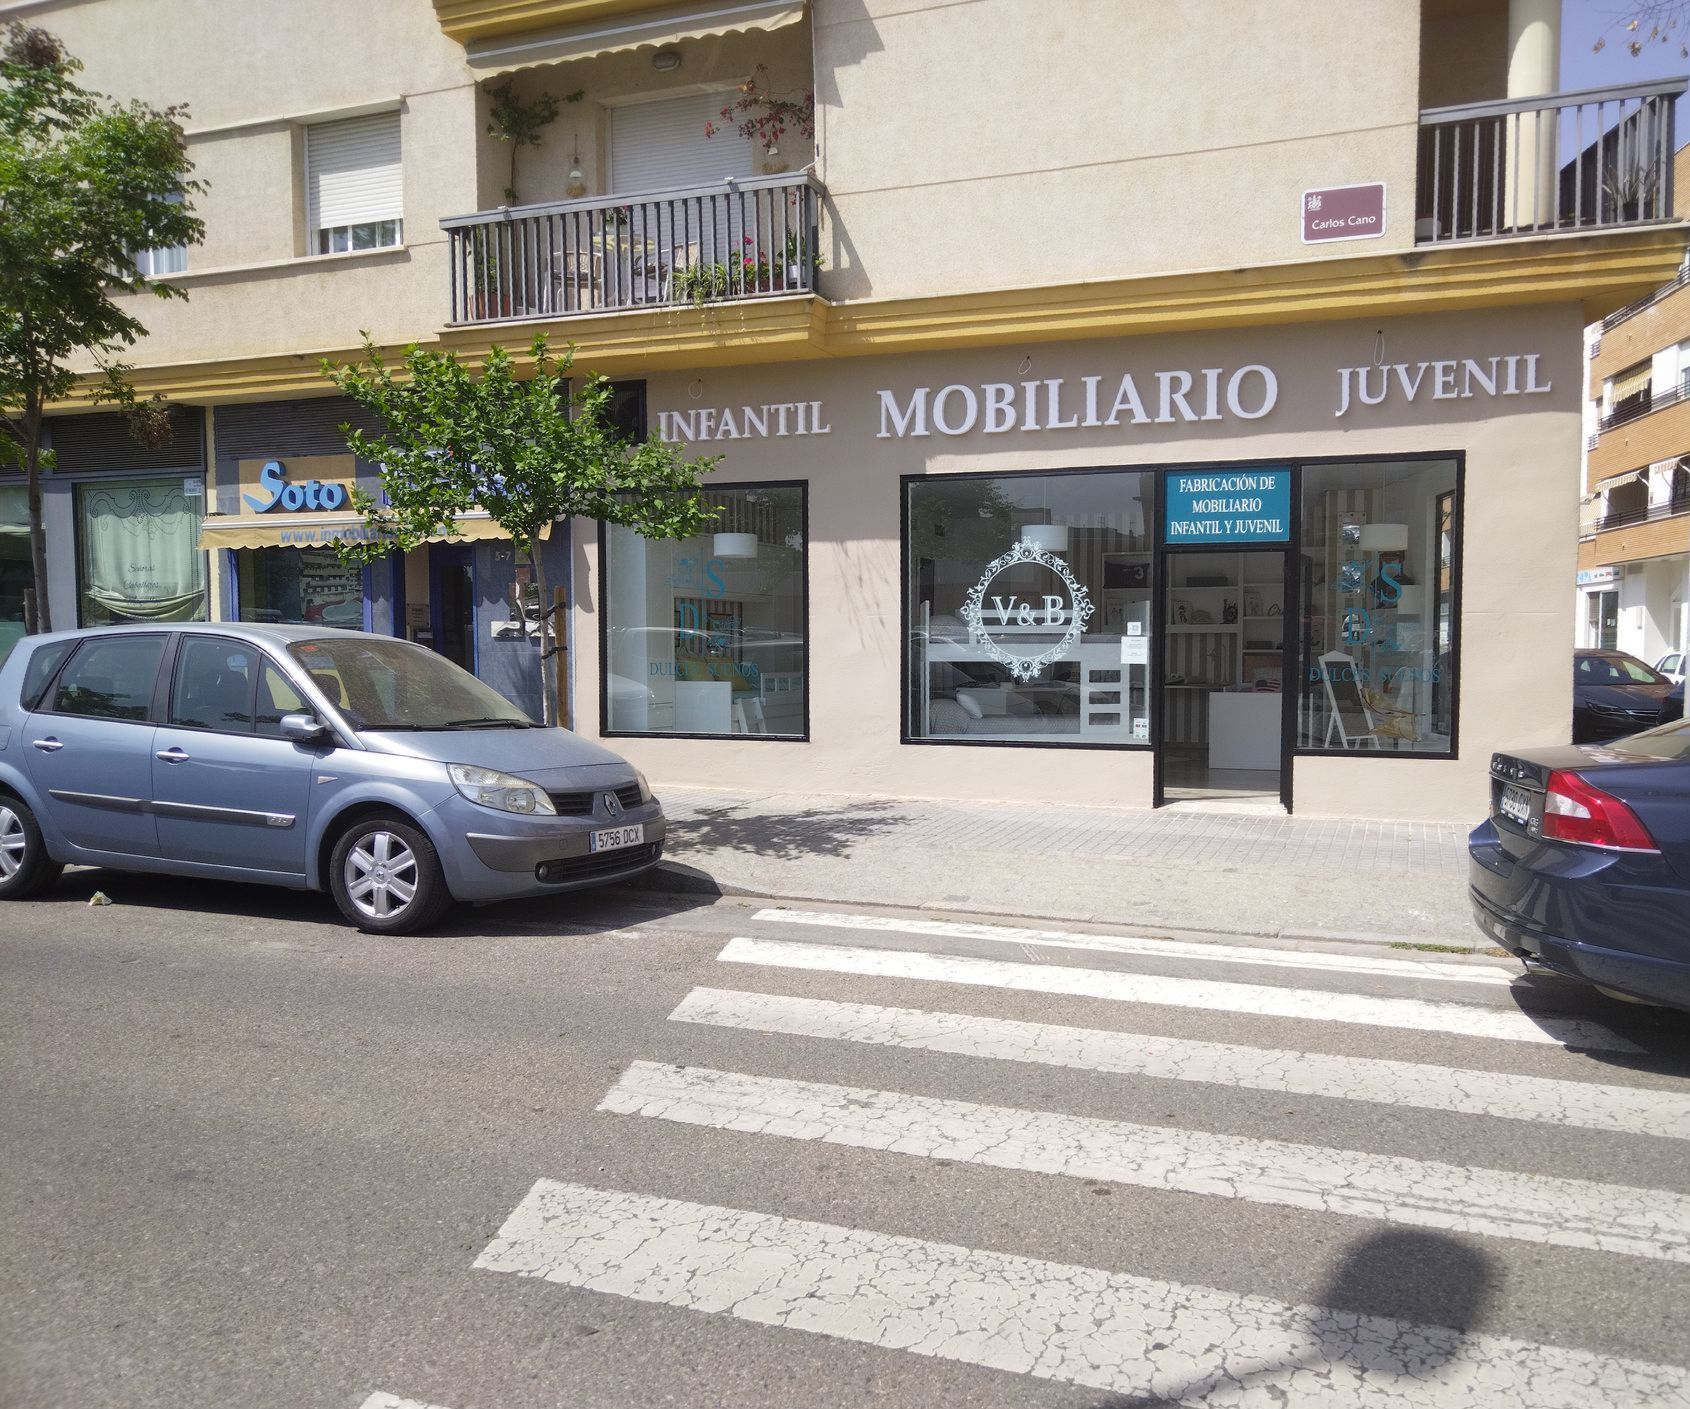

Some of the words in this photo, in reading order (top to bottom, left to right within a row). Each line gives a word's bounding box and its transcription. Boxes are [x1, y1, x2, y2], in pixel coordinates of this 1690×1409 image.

[1312, 219, 1345, 230] Carlos
[1348, 215, 1376, 226] Cano
[657, 401, 832, 442] INFANTIL
[876, 364, 1278, 438] MOBILIARIO
[1335, 354, 1552, 417] JUVENIL
[242, 460, 347, 515] Soto
[1180, 473, 1257, 492] FABRICACIÓN
[1259, 476, 1276, 490] DE
[1192, 498, 1262, 513] MOBILIARIO
[1171, 520, 1222, 534] INFANTIL
[1224, 520, 1232, 533] Y
[1234, 519, 1283, 534] JUVENIL
[598, 830, 621, 848] 5756
[623, 828, 640, 845] DCX
